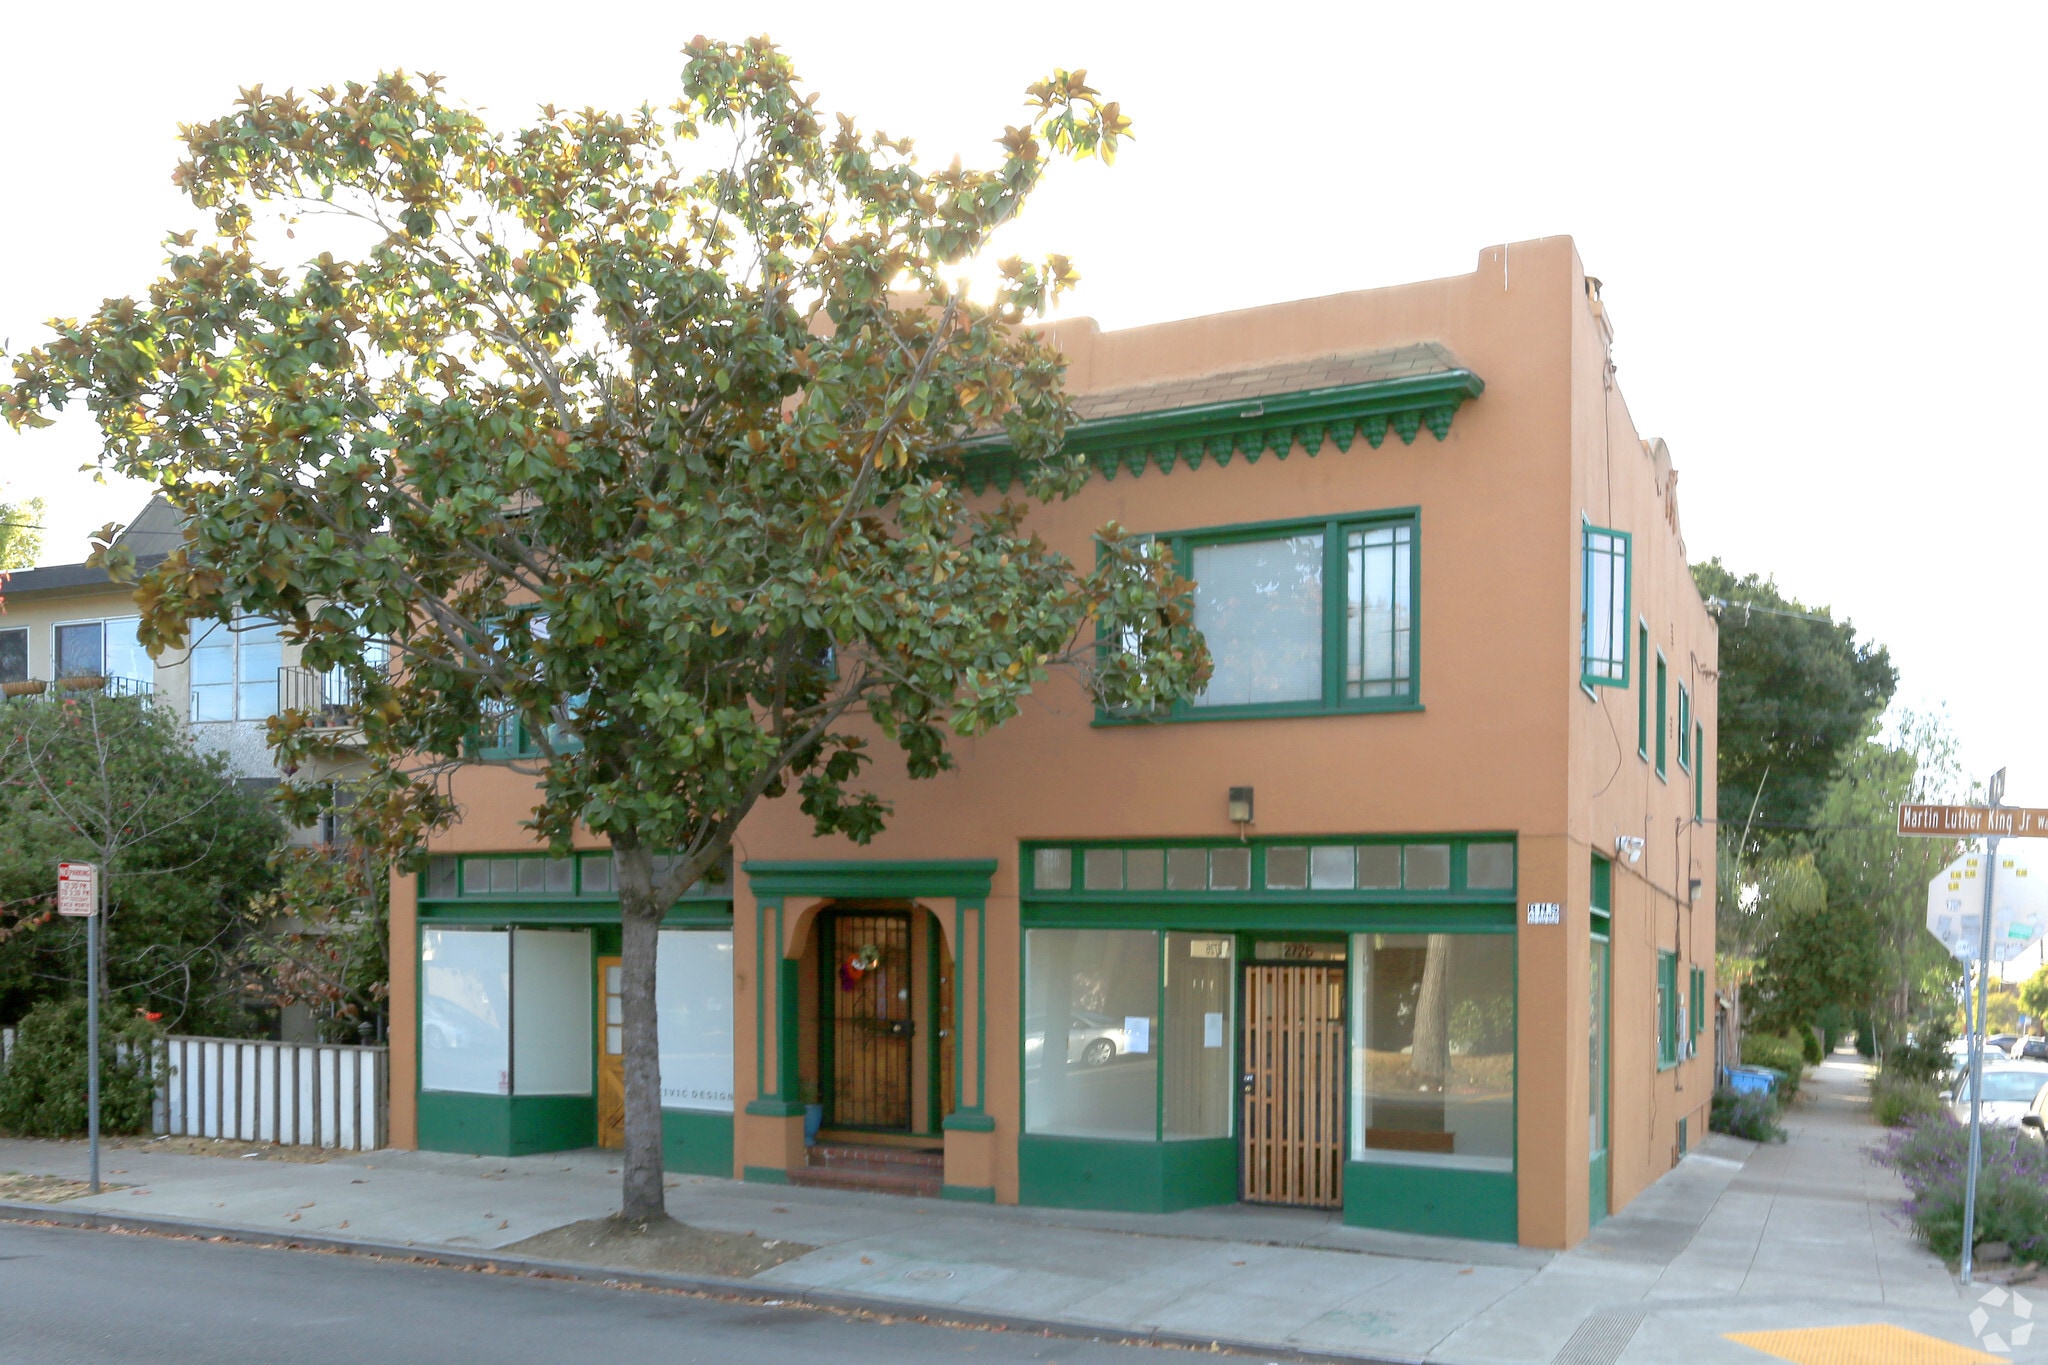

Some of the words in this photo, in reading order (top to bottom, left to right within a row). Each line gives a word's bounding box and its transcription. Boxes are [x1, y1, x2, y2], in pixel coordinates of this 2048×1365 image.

[1903, 806, 1939, 829] Martin
[1944, 807, 1982, 829] Luther
[1988, 808, 2013, 836] King
[2018, 809, 2031, 832] Jr
[1284, 942, 1314, 958] 2726
[663, 1088, 688, 1098] IVIC
[691, 1089, 734, 1101] DESIGN
